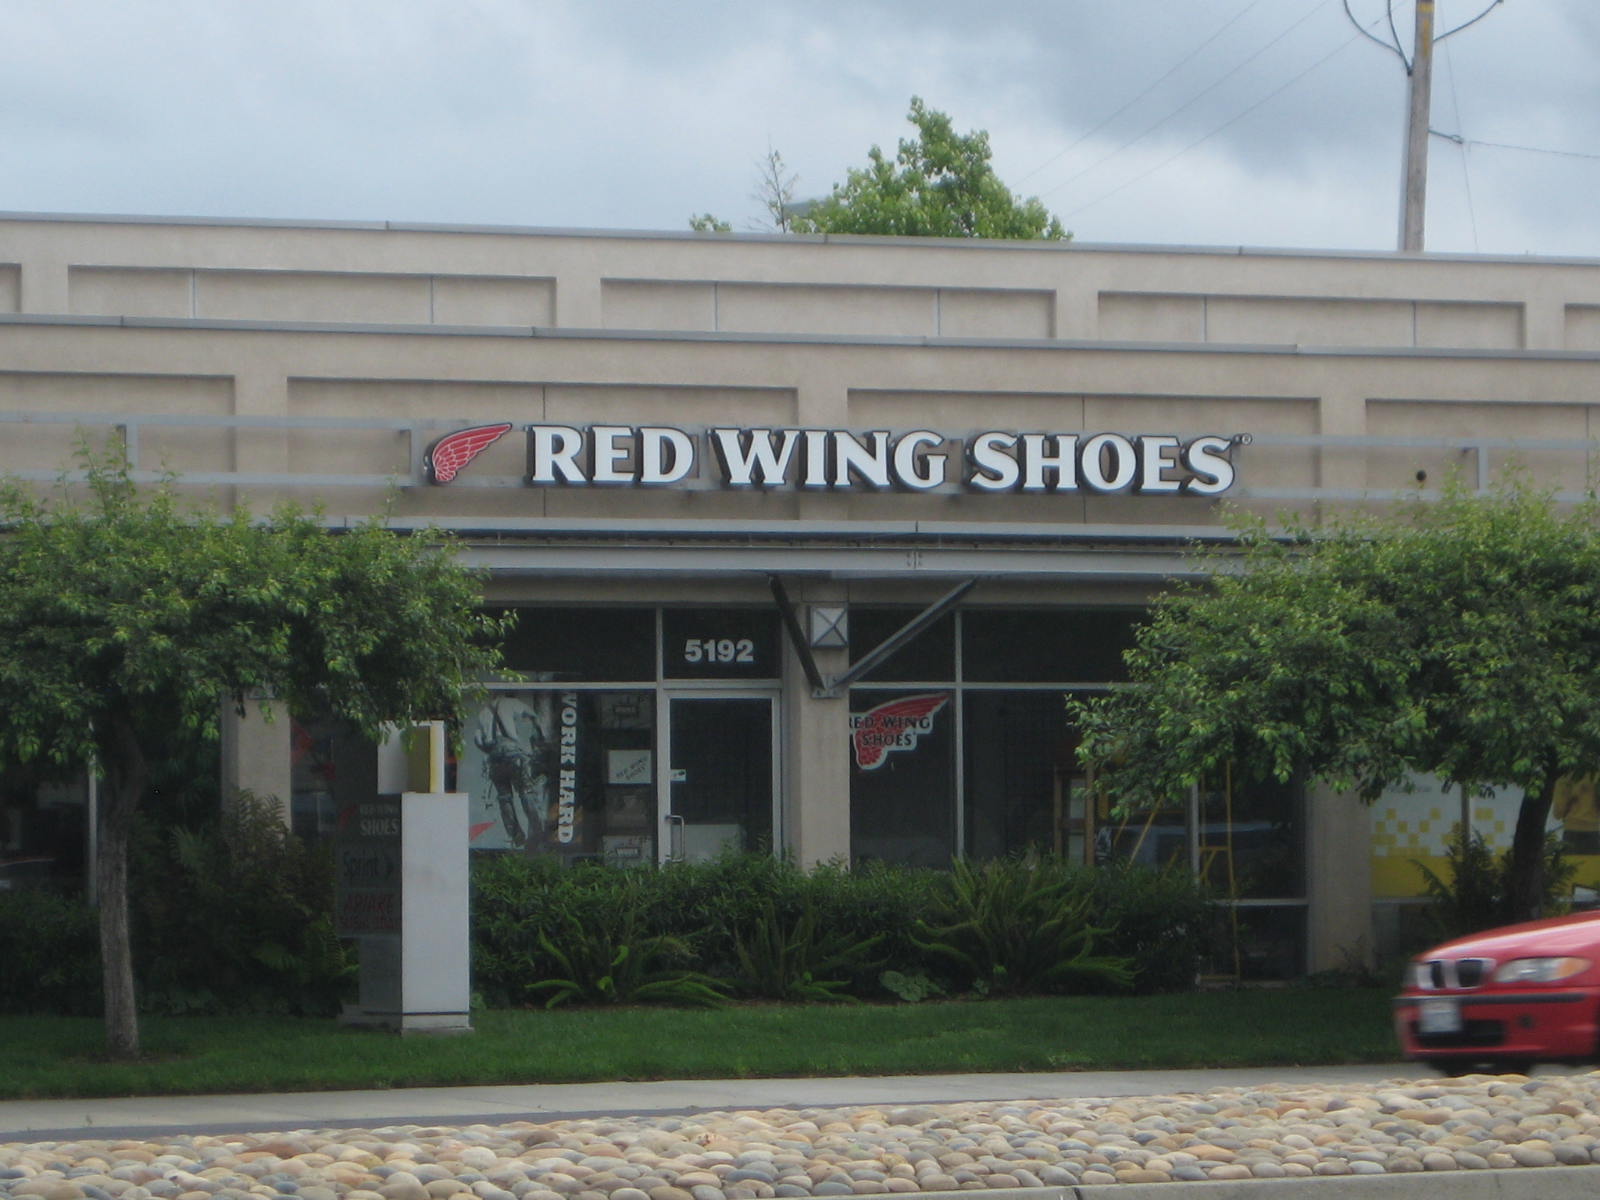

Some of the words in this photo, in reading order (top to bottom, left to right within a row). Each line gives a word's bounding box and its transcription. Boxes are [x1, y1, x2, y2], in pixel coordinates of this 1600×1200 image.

[526, 424, 695, 485] RED
[708, 428, 948, 490] WING
[966, 431, 1235, 494] SHOES
[684, 638, 755, 663] 5192
[883, 716, 931, 729] WING
[862, 733, 912, 747] SHOES
[557, 769, 576, 844] HARD
[359, 817, 399, 836] SHOES
